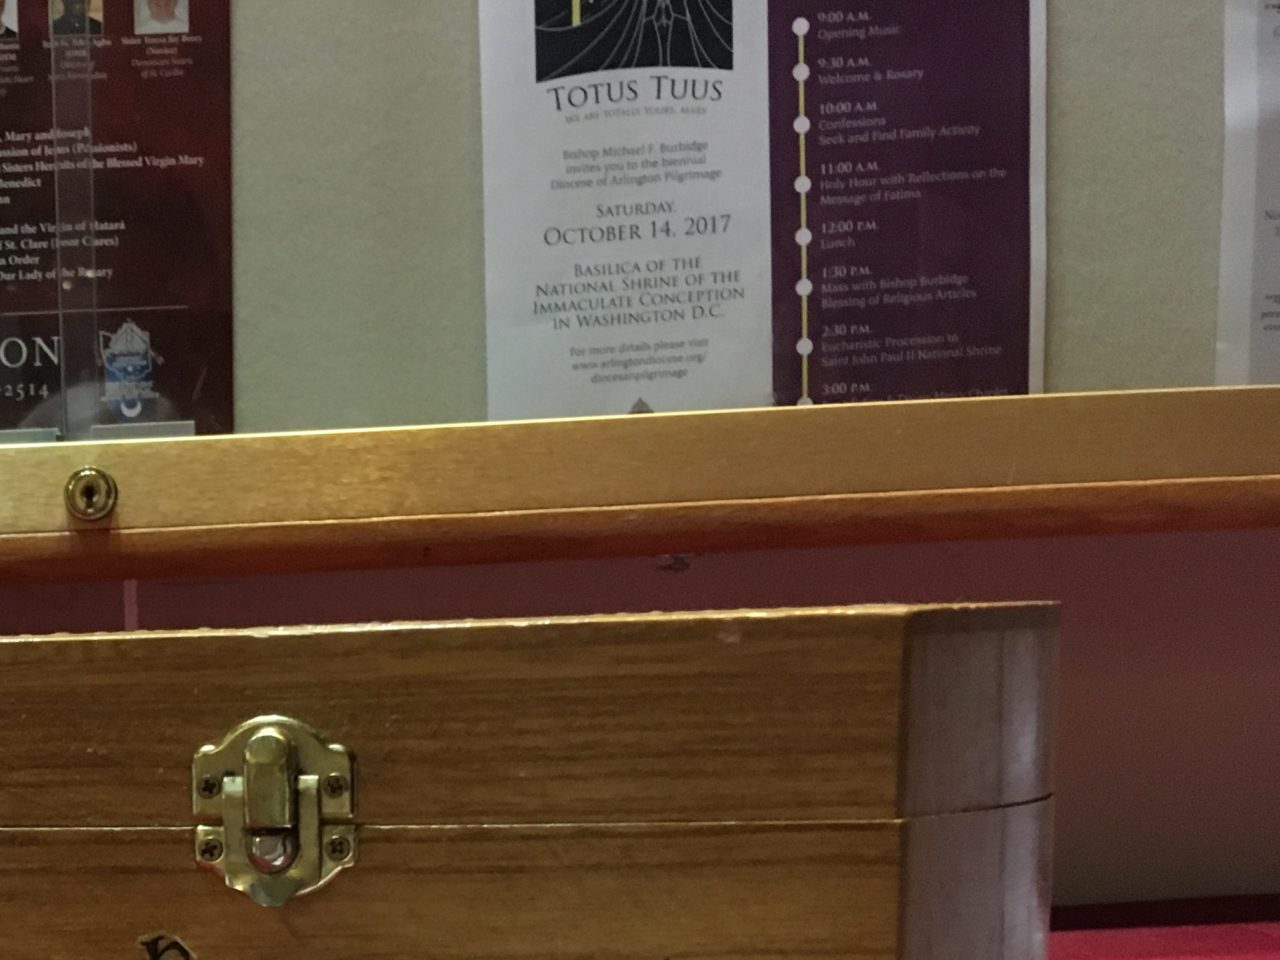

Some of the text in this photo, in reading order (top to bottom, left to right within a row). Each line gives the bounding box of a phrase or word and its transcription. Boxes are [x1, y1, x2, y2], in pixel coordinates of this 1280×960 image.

[546, 75, 724, 111] TOTUS TUUS
[821, 161, 852, 176] 11:00
[543, 224, 641, 246] OCTOBER
[684, 214, 732, 237] 2017
[822, 220, 854, 234] 12:00
[820, 236, 856, 250] Lunch
[573, 255, 702, 278] BASILICA OF THE
[535, 270, 741, 298] NATIONAL SHRINE OF THE
[532, 287, 745, 315] IMMACULATE CONCEPTION
[577, 308, 686, 329] WASHINGTON
